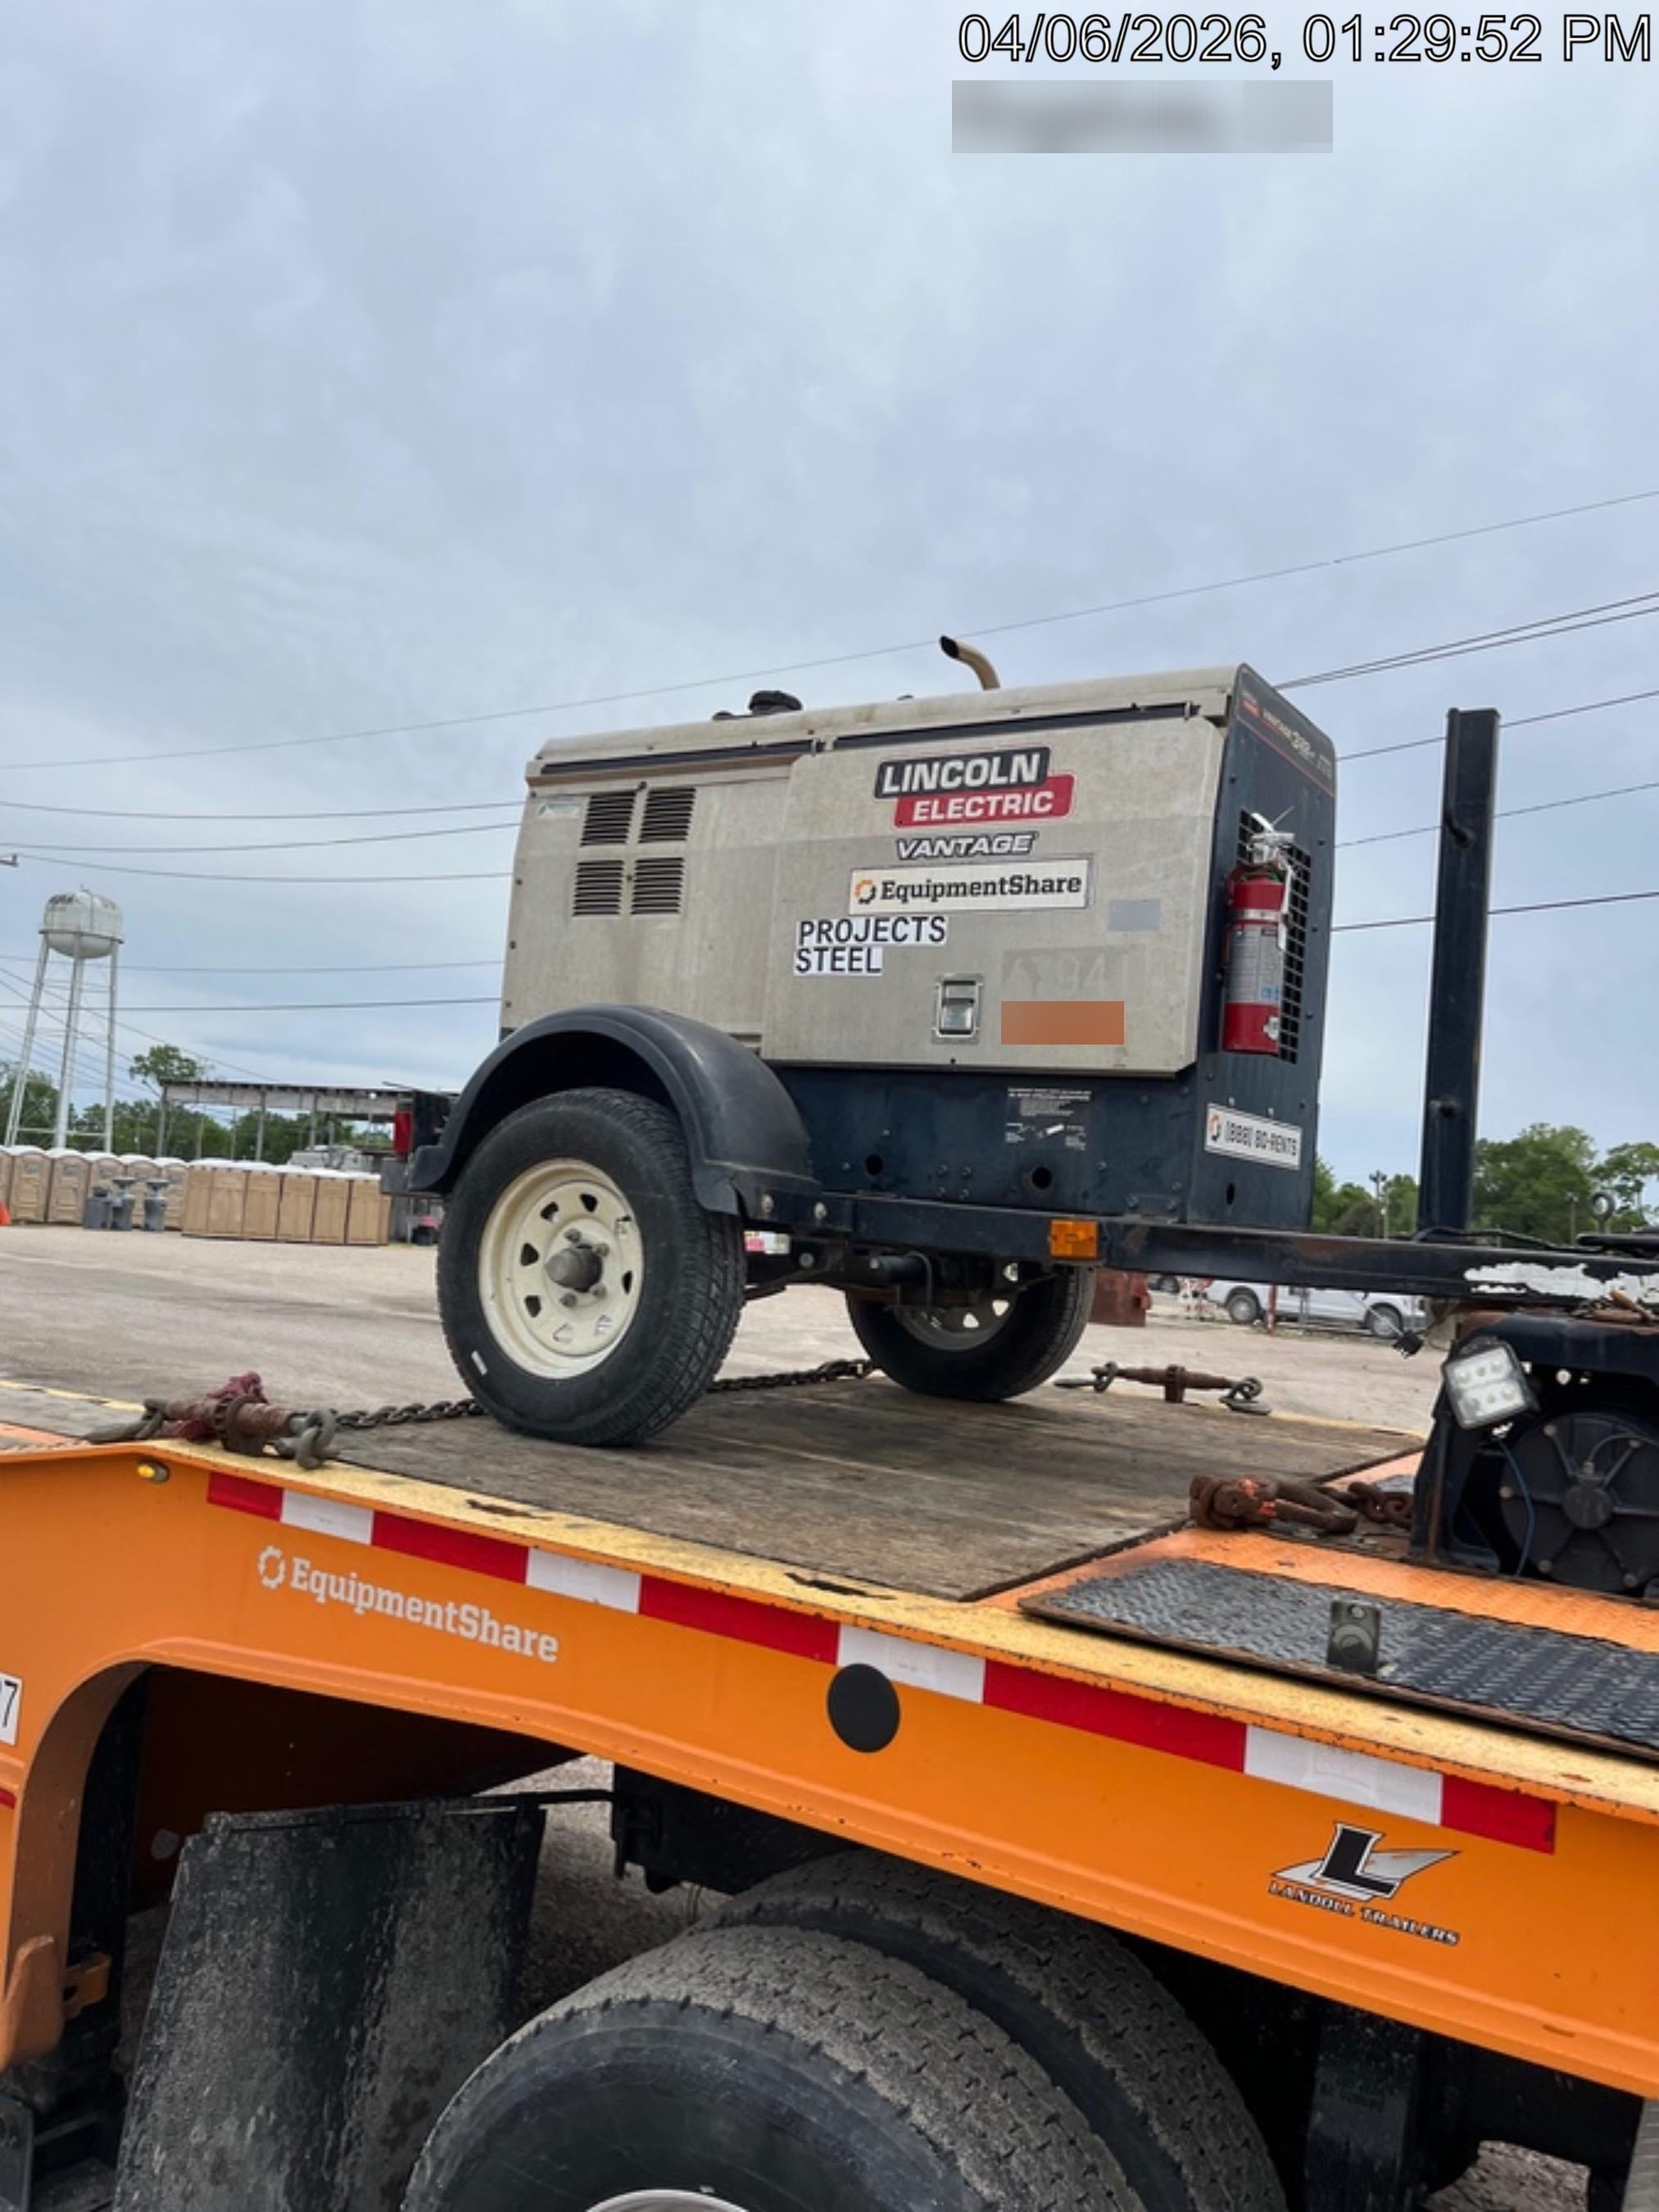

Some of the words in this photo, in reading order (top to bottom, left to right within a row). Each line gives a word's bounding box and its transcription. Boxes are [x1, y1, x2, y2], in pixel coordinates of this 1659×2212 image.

[882, 753, 1040, 795] LINCOLN
[913, 791, 1054, 822] ELECTRIC
[897, 834, 1034, 859] VANTAGE
[881, 874, 1082, 903] EquipmentShare
[799, 917, 946, 945] PROJECTS
[796, 947, 882, 974] STEEL
[291, 1557, 559, 1662] EquipmentShare
[1268, 1880, 1354, 1917] LANDOLL
[1361, 1907, 1460, 1946] TRAILERS
